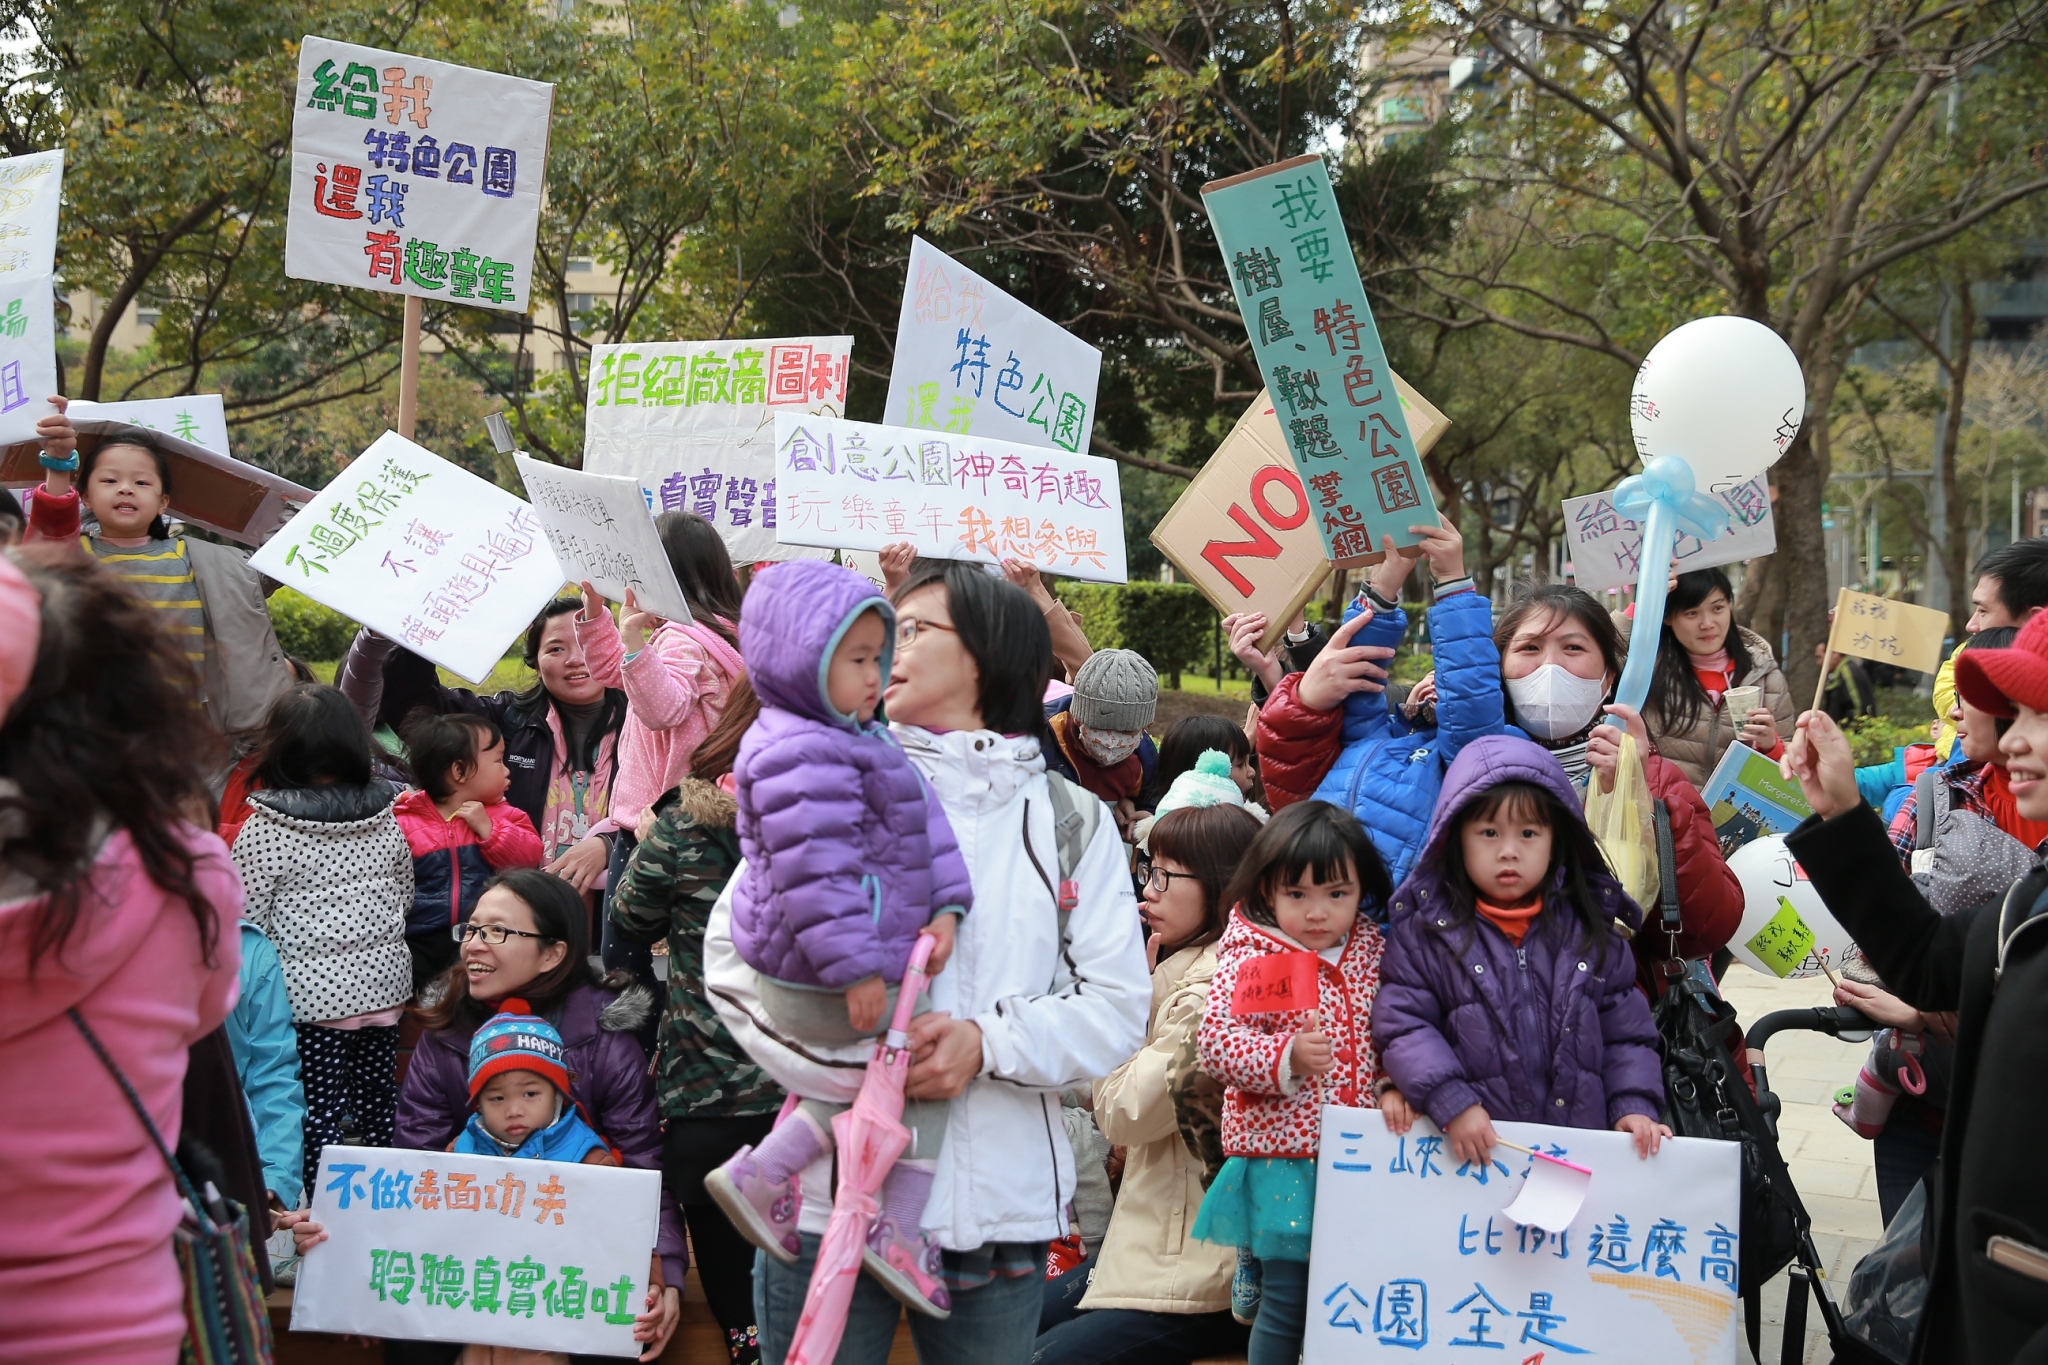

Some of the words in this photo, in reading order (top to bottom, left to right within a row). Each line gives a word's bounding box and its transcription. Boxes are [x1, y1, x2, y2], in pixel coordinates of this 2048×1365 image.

[306, 59, 434, 129] 給我
[313, 162, 409, 228] 還我
[363, 128, 517, 198] 特色公園
[363, 230, 516, 304] 有趣童年
[914, 257, 986, 333] 給我
[595, 344, 849, 408] 拒絕廠商圖利
[950, 327, 1087, 453] 特色公園
[779, 426, 1113, 510] 創意公園神奇有趣
[285, 458, 433, 577] 不過度保護
[381, 517, 454, 577] 不讓
[786, 490, 1109, 571] 玩樂童年我想參與
[1200, 464, 1310, 599] NO
[517, 1034, 564, 1061] HAPPY
[326, 1163, 567, 1226] 不做表面功夫
[369, 1249, 637, 1326] 聆聽真實傾吐
[1323, 1277, 1598, 1355] 公園全是
